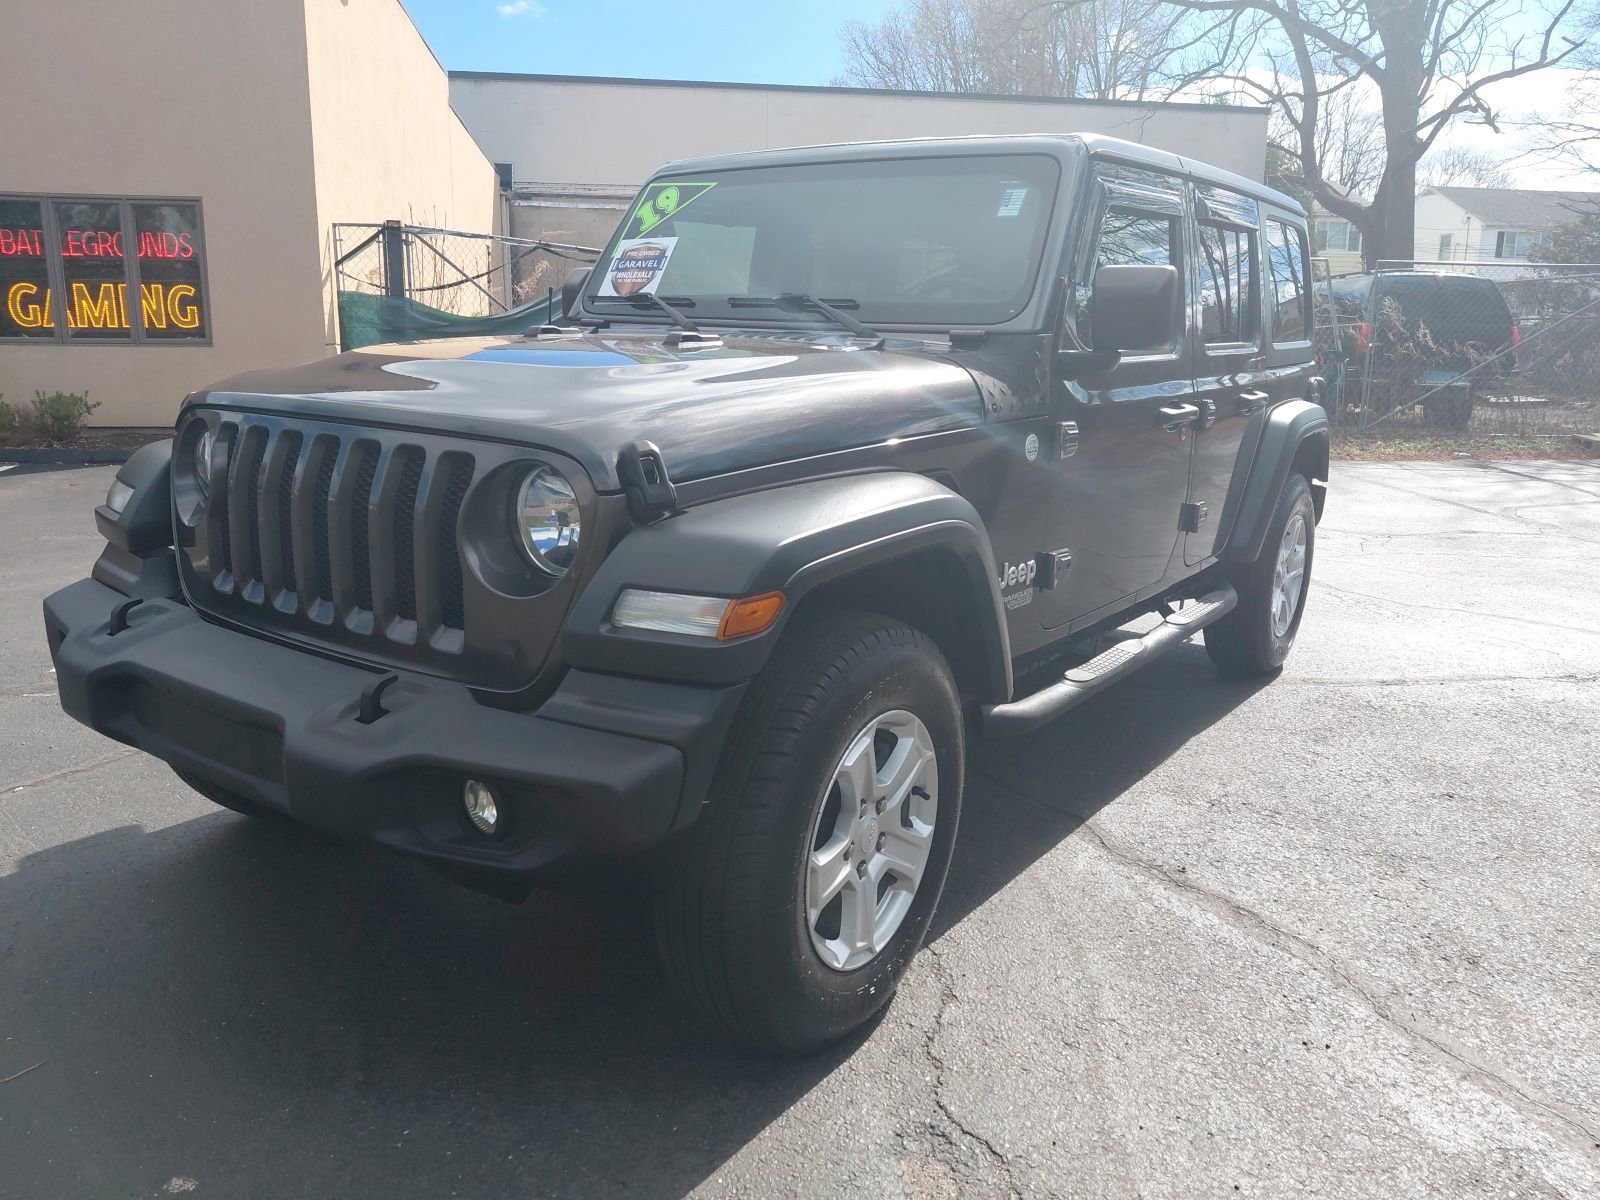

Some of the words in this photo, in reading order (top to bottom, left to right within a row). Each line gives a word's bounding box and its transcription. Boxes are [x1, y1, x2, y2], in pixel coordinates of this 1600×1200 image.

[636, 186, 679, 231] 19
[0, 229, 193, 258] BATEGROUNDS
[616, 271, 653, 279] WHOLESALE
[618, 259, 659, 269] GARAVEL
[999, 560, 1036, 590] Jeep
